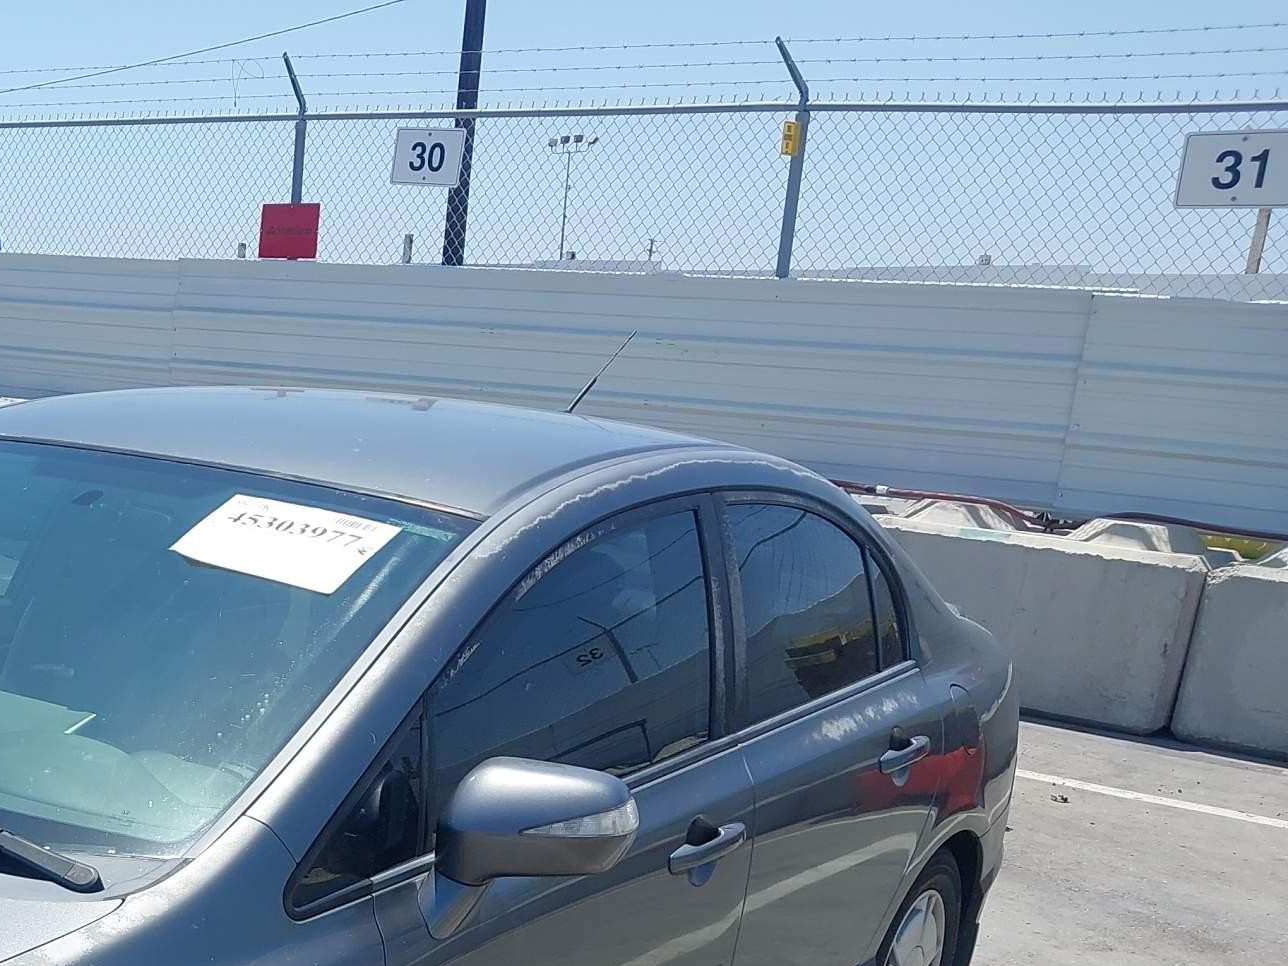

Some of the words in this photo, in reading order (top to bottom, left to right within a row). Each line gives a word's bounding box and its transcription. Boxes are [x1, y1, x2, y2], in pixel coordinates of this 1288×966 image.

[408, 141, 446, 173] 30
[1211, 148, 1270, 190] 31
[227, 511, 363, 547] 45303977
